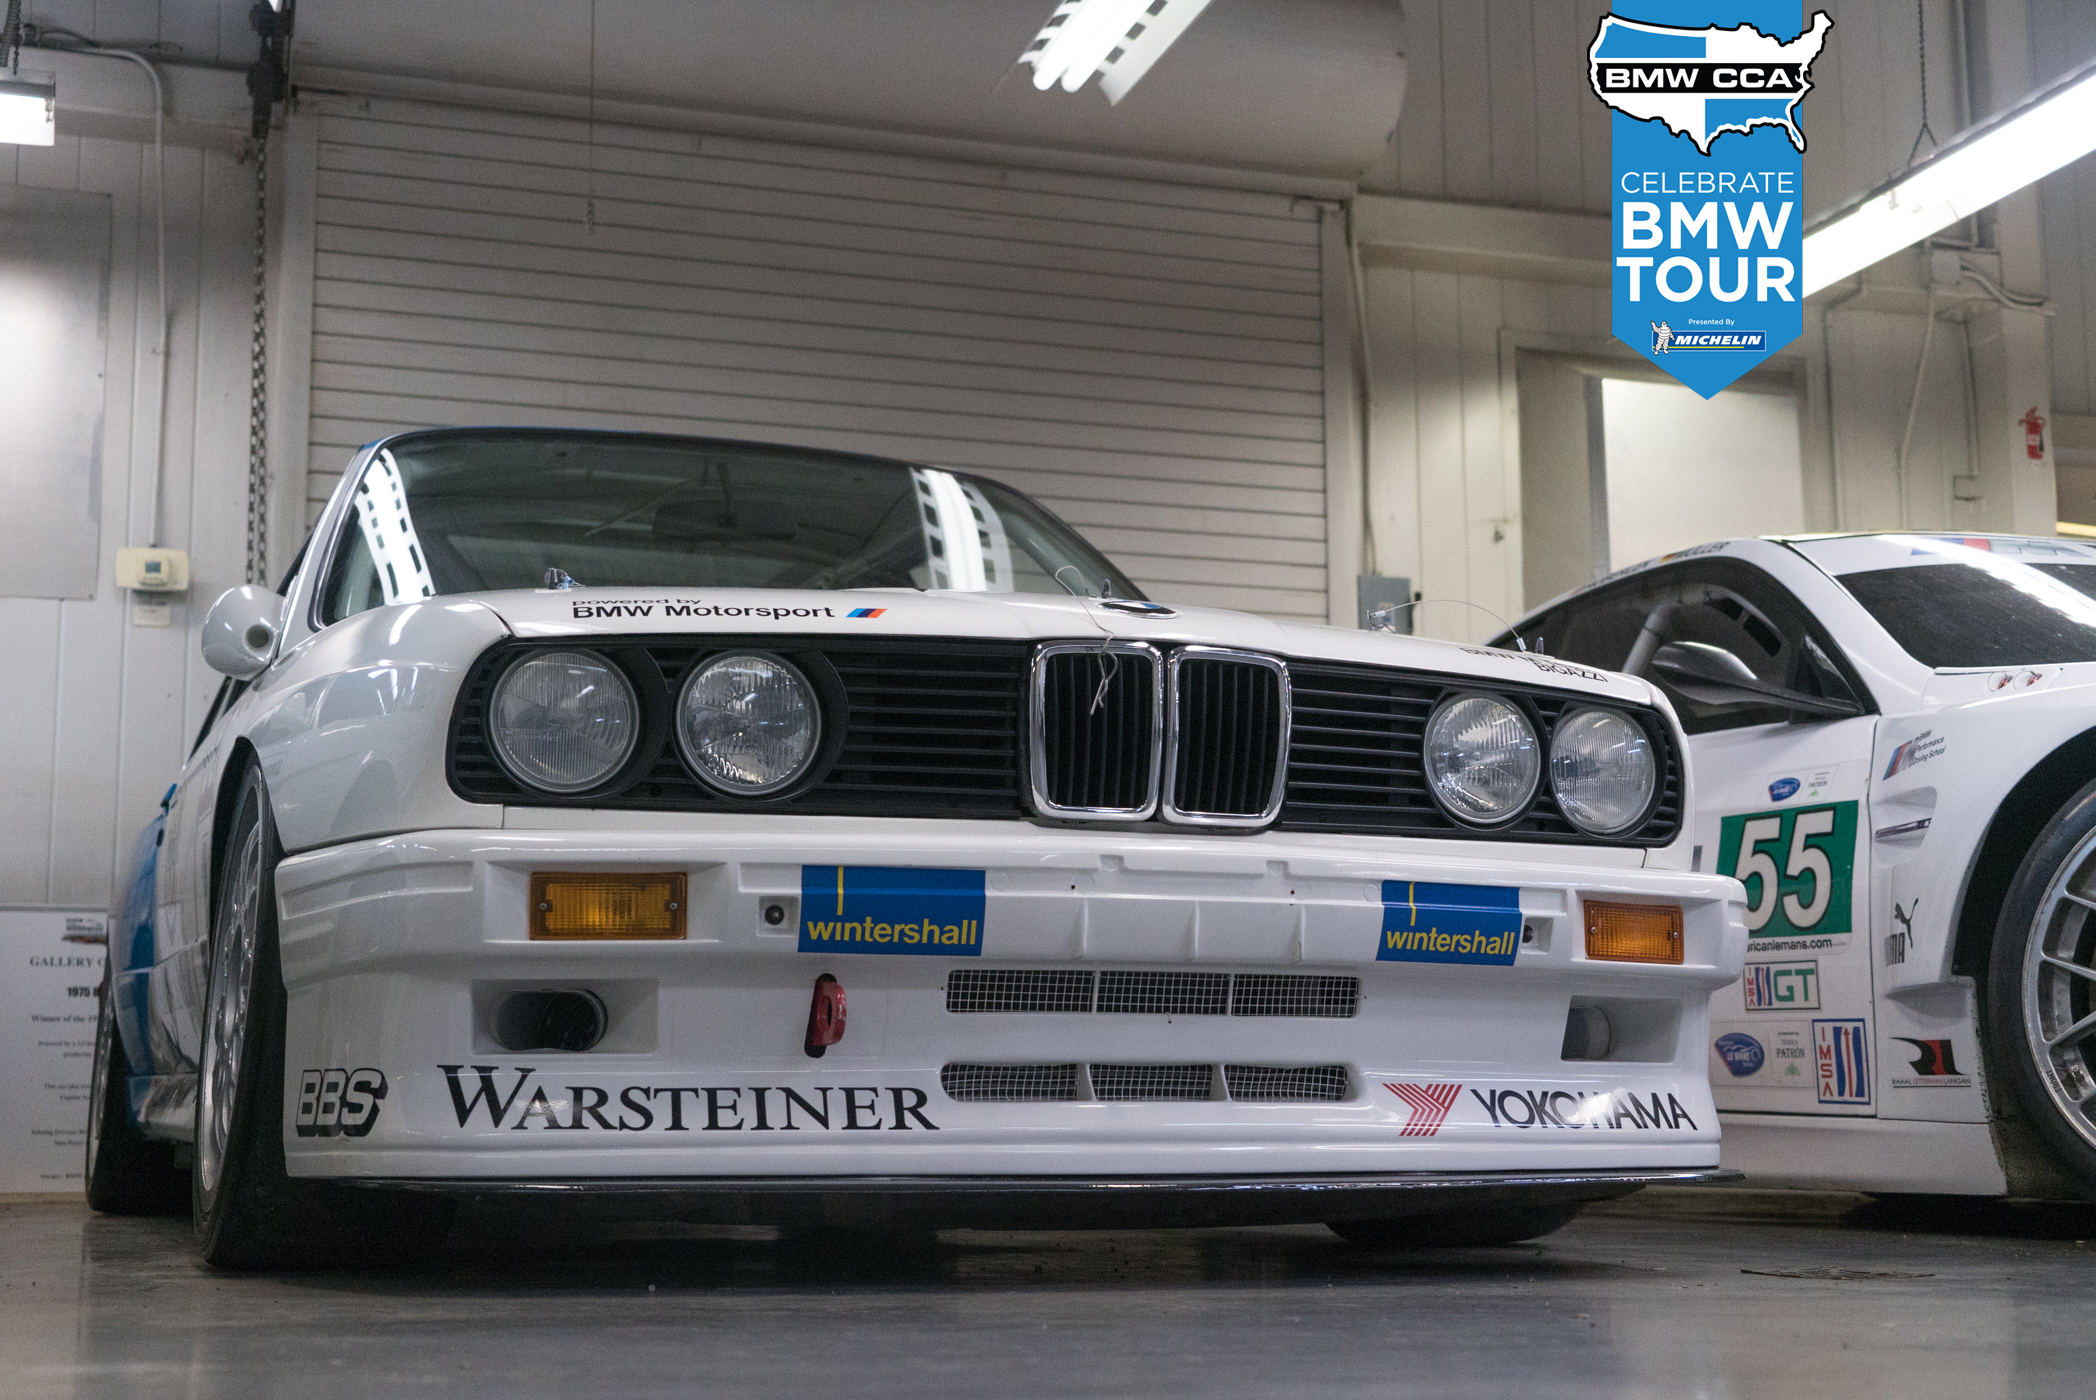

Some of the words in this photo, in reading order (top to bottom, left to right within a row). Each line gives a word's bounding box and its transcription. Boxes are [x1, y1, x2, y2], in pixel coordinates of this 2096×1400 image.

[572, 605, 653, 618] BMW
[665, 605, 835, 620] Motorsport
[1735, 806, 1836, 933] 55
[807, 916, 977, 945] wintershall
[1387, 927, 1515, 955] wintershall
[30, 957, 92, 967] GALLERY
[68, 986, 91, 998] 1975
[1773, 968, 1815, 1002] GT
[1818, 1026, 1834, 1097] IMSA
[296, 1067, 389, 1138] BBS
[437, 1064, 940, 1132] WARSTEINER
